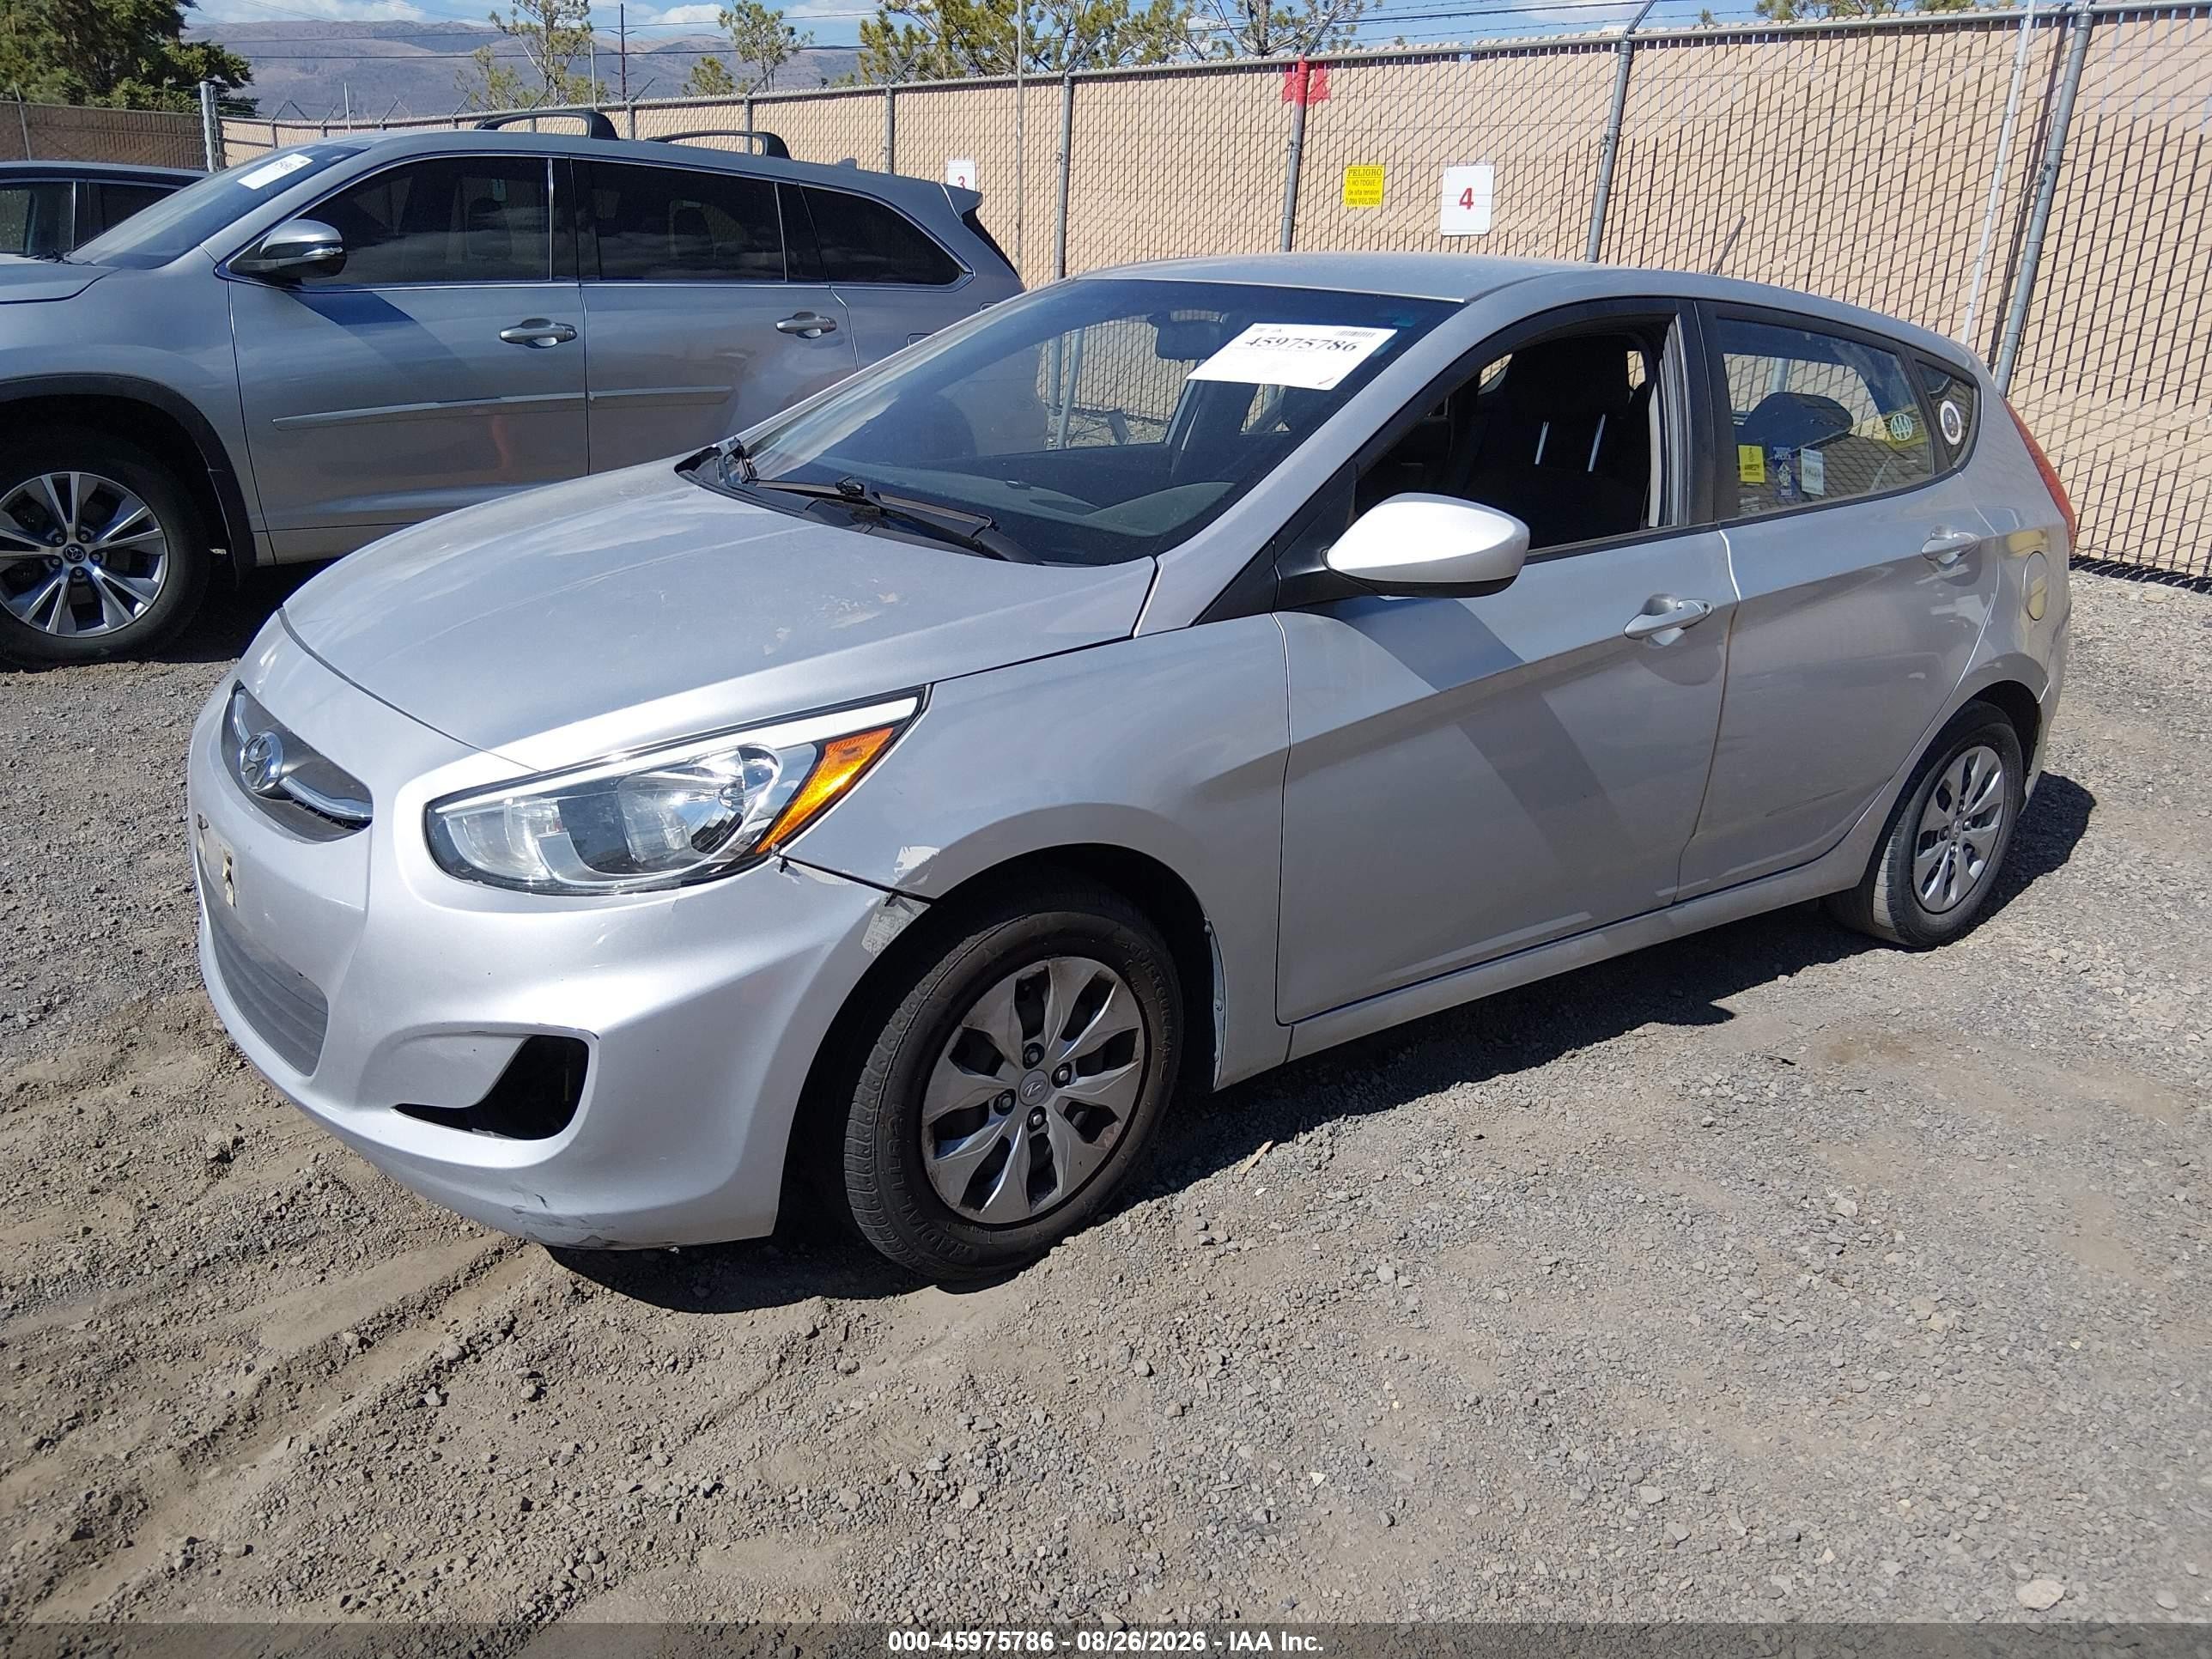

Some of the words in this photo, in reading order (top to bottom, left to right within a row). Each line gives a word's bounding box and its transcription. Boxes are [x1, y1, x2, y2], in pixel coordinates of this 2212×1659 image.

[1347, 168, 1382, 177] PELIGRO
[1458, 187, 1474, 210] 4
[1244, 336, 1360, 352] 45975786
